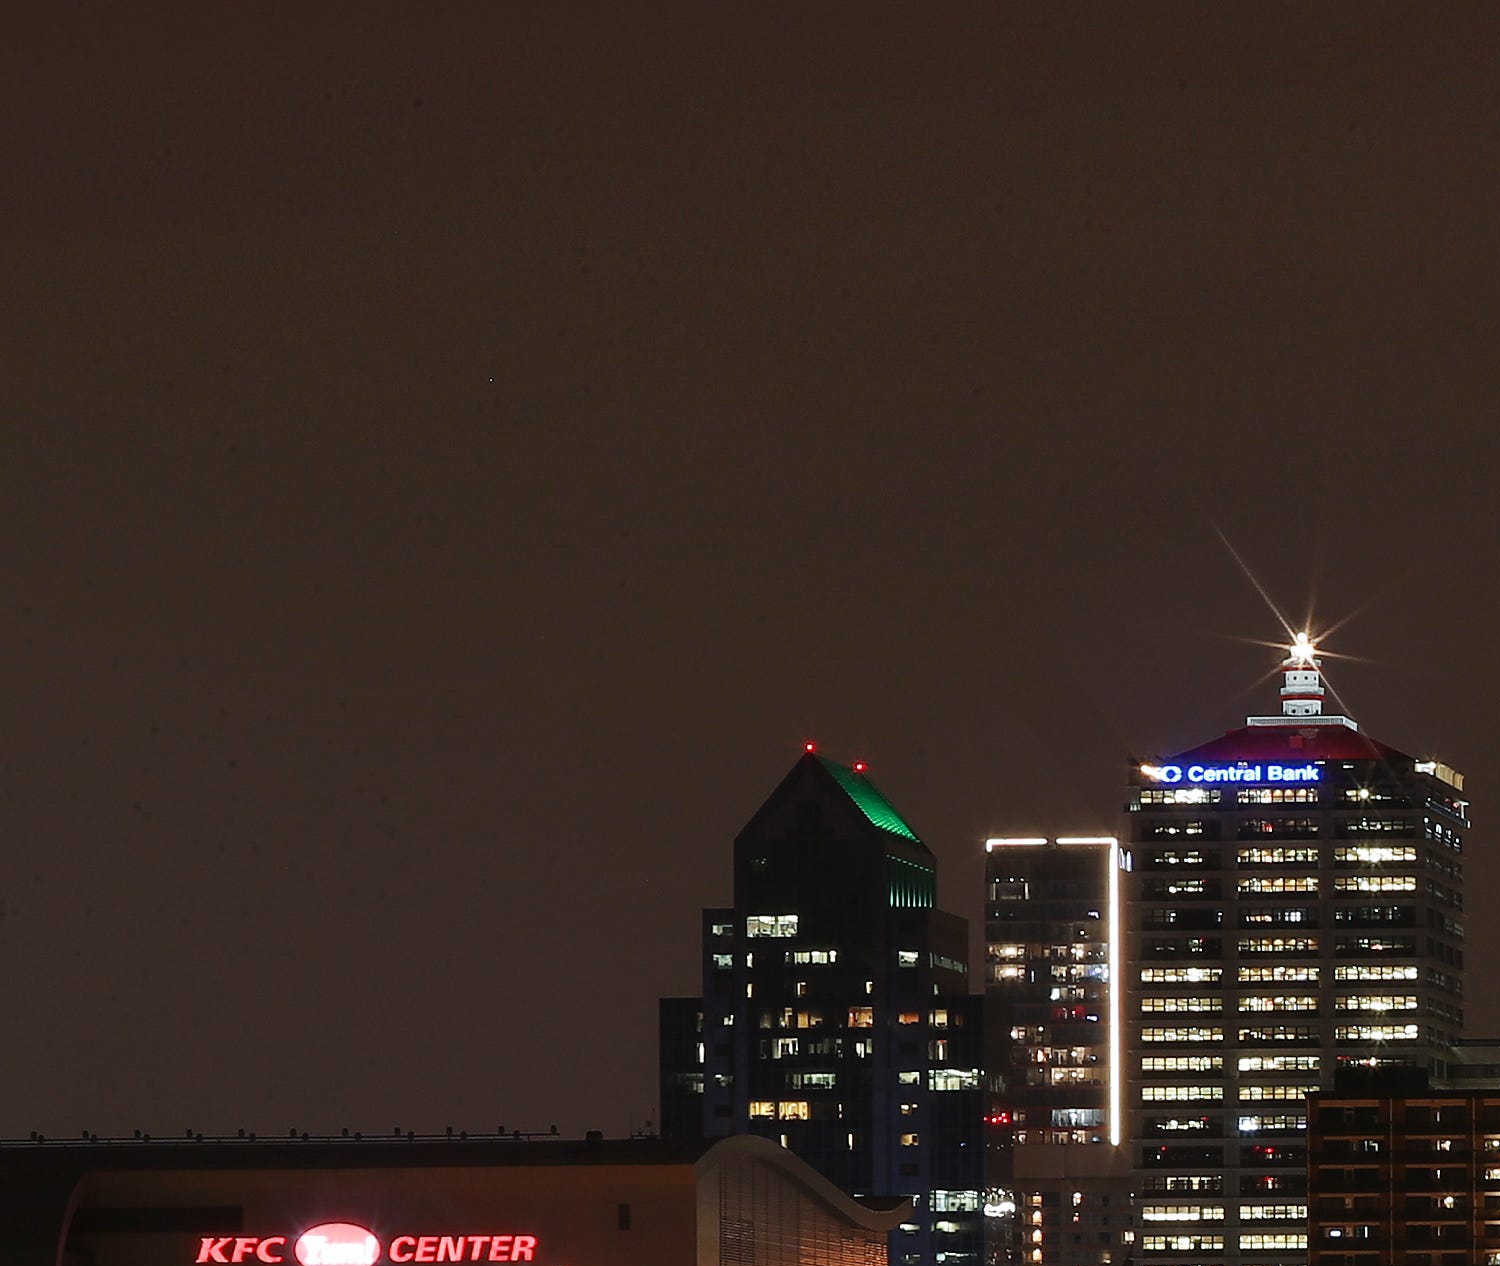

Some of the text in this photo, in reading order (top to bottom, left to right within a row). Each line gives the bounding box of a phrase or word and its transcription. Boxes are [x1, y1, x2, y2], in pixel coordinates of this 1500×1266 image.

[1188, 765, 1319, 782] Central Bank
[195, 1236, 285, 1264] KFC
[389, 1235, 537, 1263] CENTER
